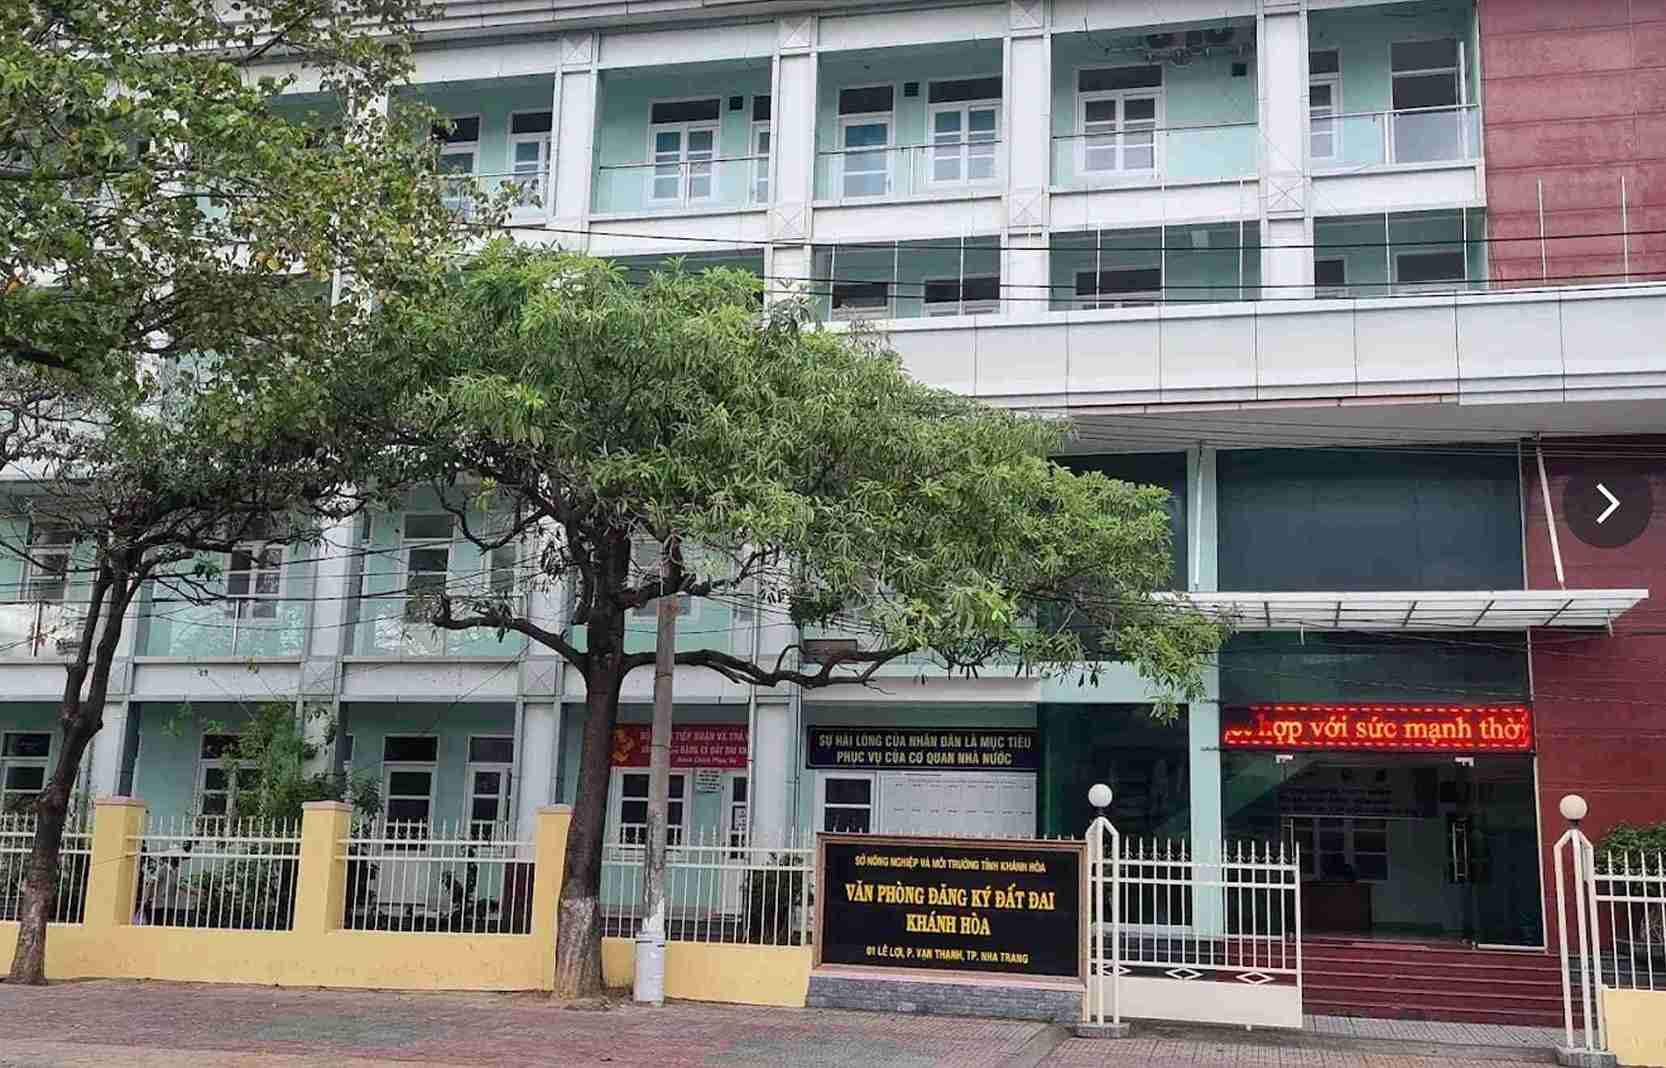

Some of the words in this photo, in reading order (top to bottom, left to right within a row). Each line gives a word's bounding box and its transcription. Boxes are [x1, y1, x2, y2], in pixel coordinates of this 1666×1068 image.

[1310, 715, 1347, 738] với
[1355, 715, 1397, 739] sức
[1403, 716, 1472, 744] mạnh
[885, 733, 906, 747] CỦA
[909, 733, 938, 748] NHÂN
[964, 734, 977, 748] LÀ
[980, 735, 1004, 750] MỤC
[1007, 735, 1031, 749] TIÊU
[867, 751, 882, 765] VỤ
[885, 749, 906, 764] CỦA
[926, 752, 955, 765] QUAN
[957, 750, 980, 765] NHÀ
[982, 750, 1012, 765] NƯỚC
[866, 854, 889, 867] NÔNG
[890, 856, 919, 869] NGHIỆP
[920, 856, 930, 868] VÀ
[947, 857, 979, 870] TRƯỜNG
[1000, 859, 1027, 872] KHÁNH
[1028, 860, 1046, 873] HÒA
[845, 879, 874, 902] VĂN
[877, 881, 925, 904] PHÒNG
[928, 883, 968, 906] ĐĂNG
[971, 885, 992, 908] KÝ
[995, 883, 1026, 909] ĐẤT
[1028, 891, 1055, 910] ĐAI
[906, 911, 956, 932] KHÁNH
[960, 912, 992, 935] HÒA
[877, 944, 888, 957] LÊ
[906, 948, 915, 958] P.
[966, 950, 979, 961] TP.
[980, 951, 998, 962] NHA
[1001, 952, 1029, 964] TRANG
